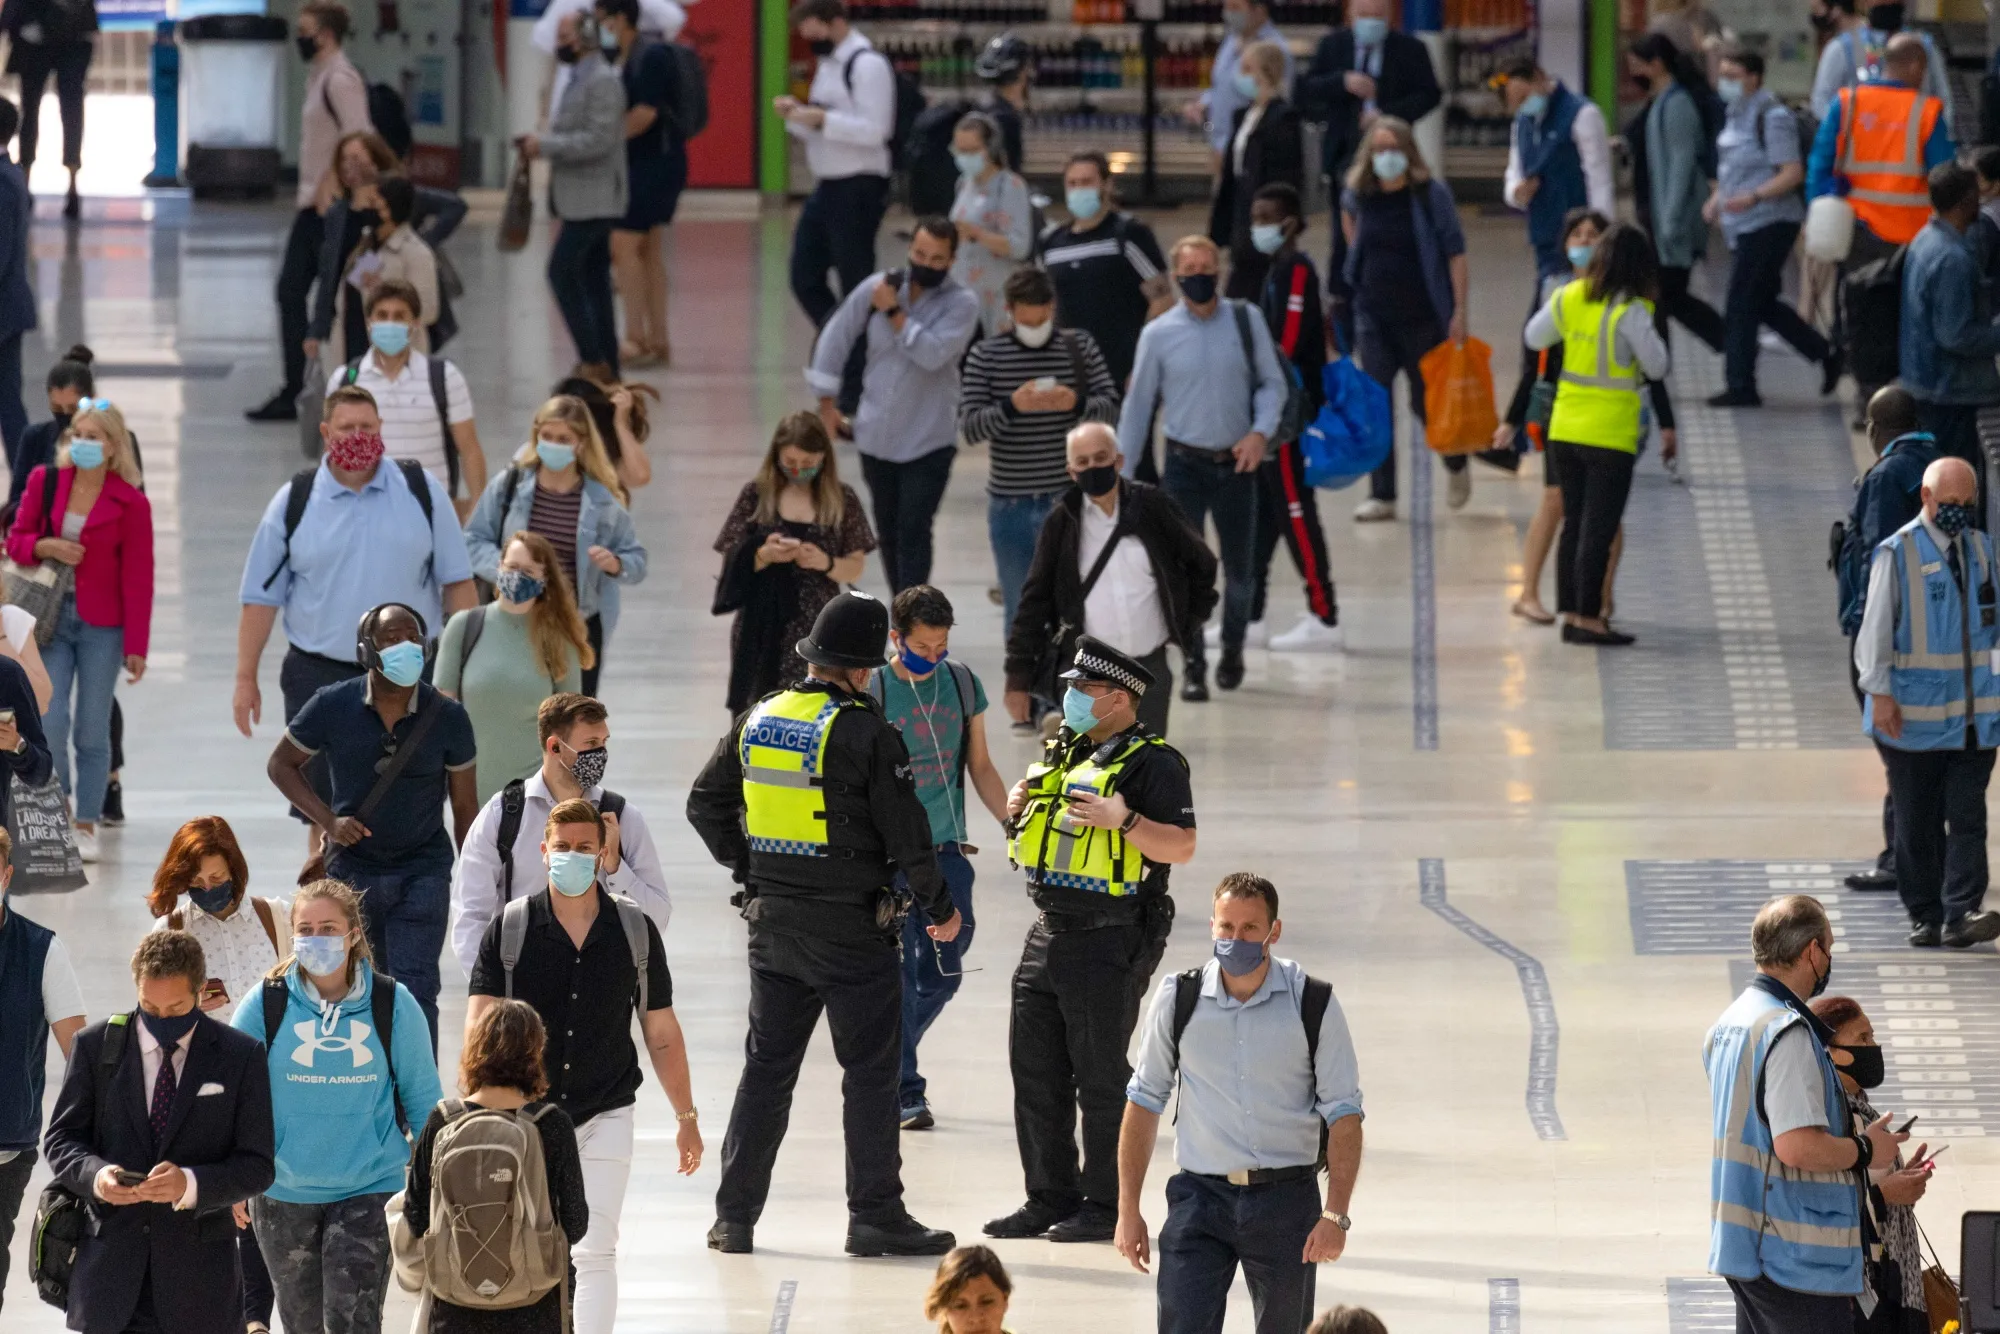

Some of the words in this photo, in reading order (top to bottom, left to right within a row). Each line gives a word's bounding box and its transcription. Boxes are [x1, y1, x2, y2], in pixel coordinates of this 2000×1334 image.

[776, 721, 814, 733] TRANSPORT
[747, 725, 811, 749] POLICE
[19, 828, 27, 842] A
[286, 1073, 326, 1084] UNDER
[328, 1074, 378, 1084] ARMOUR
